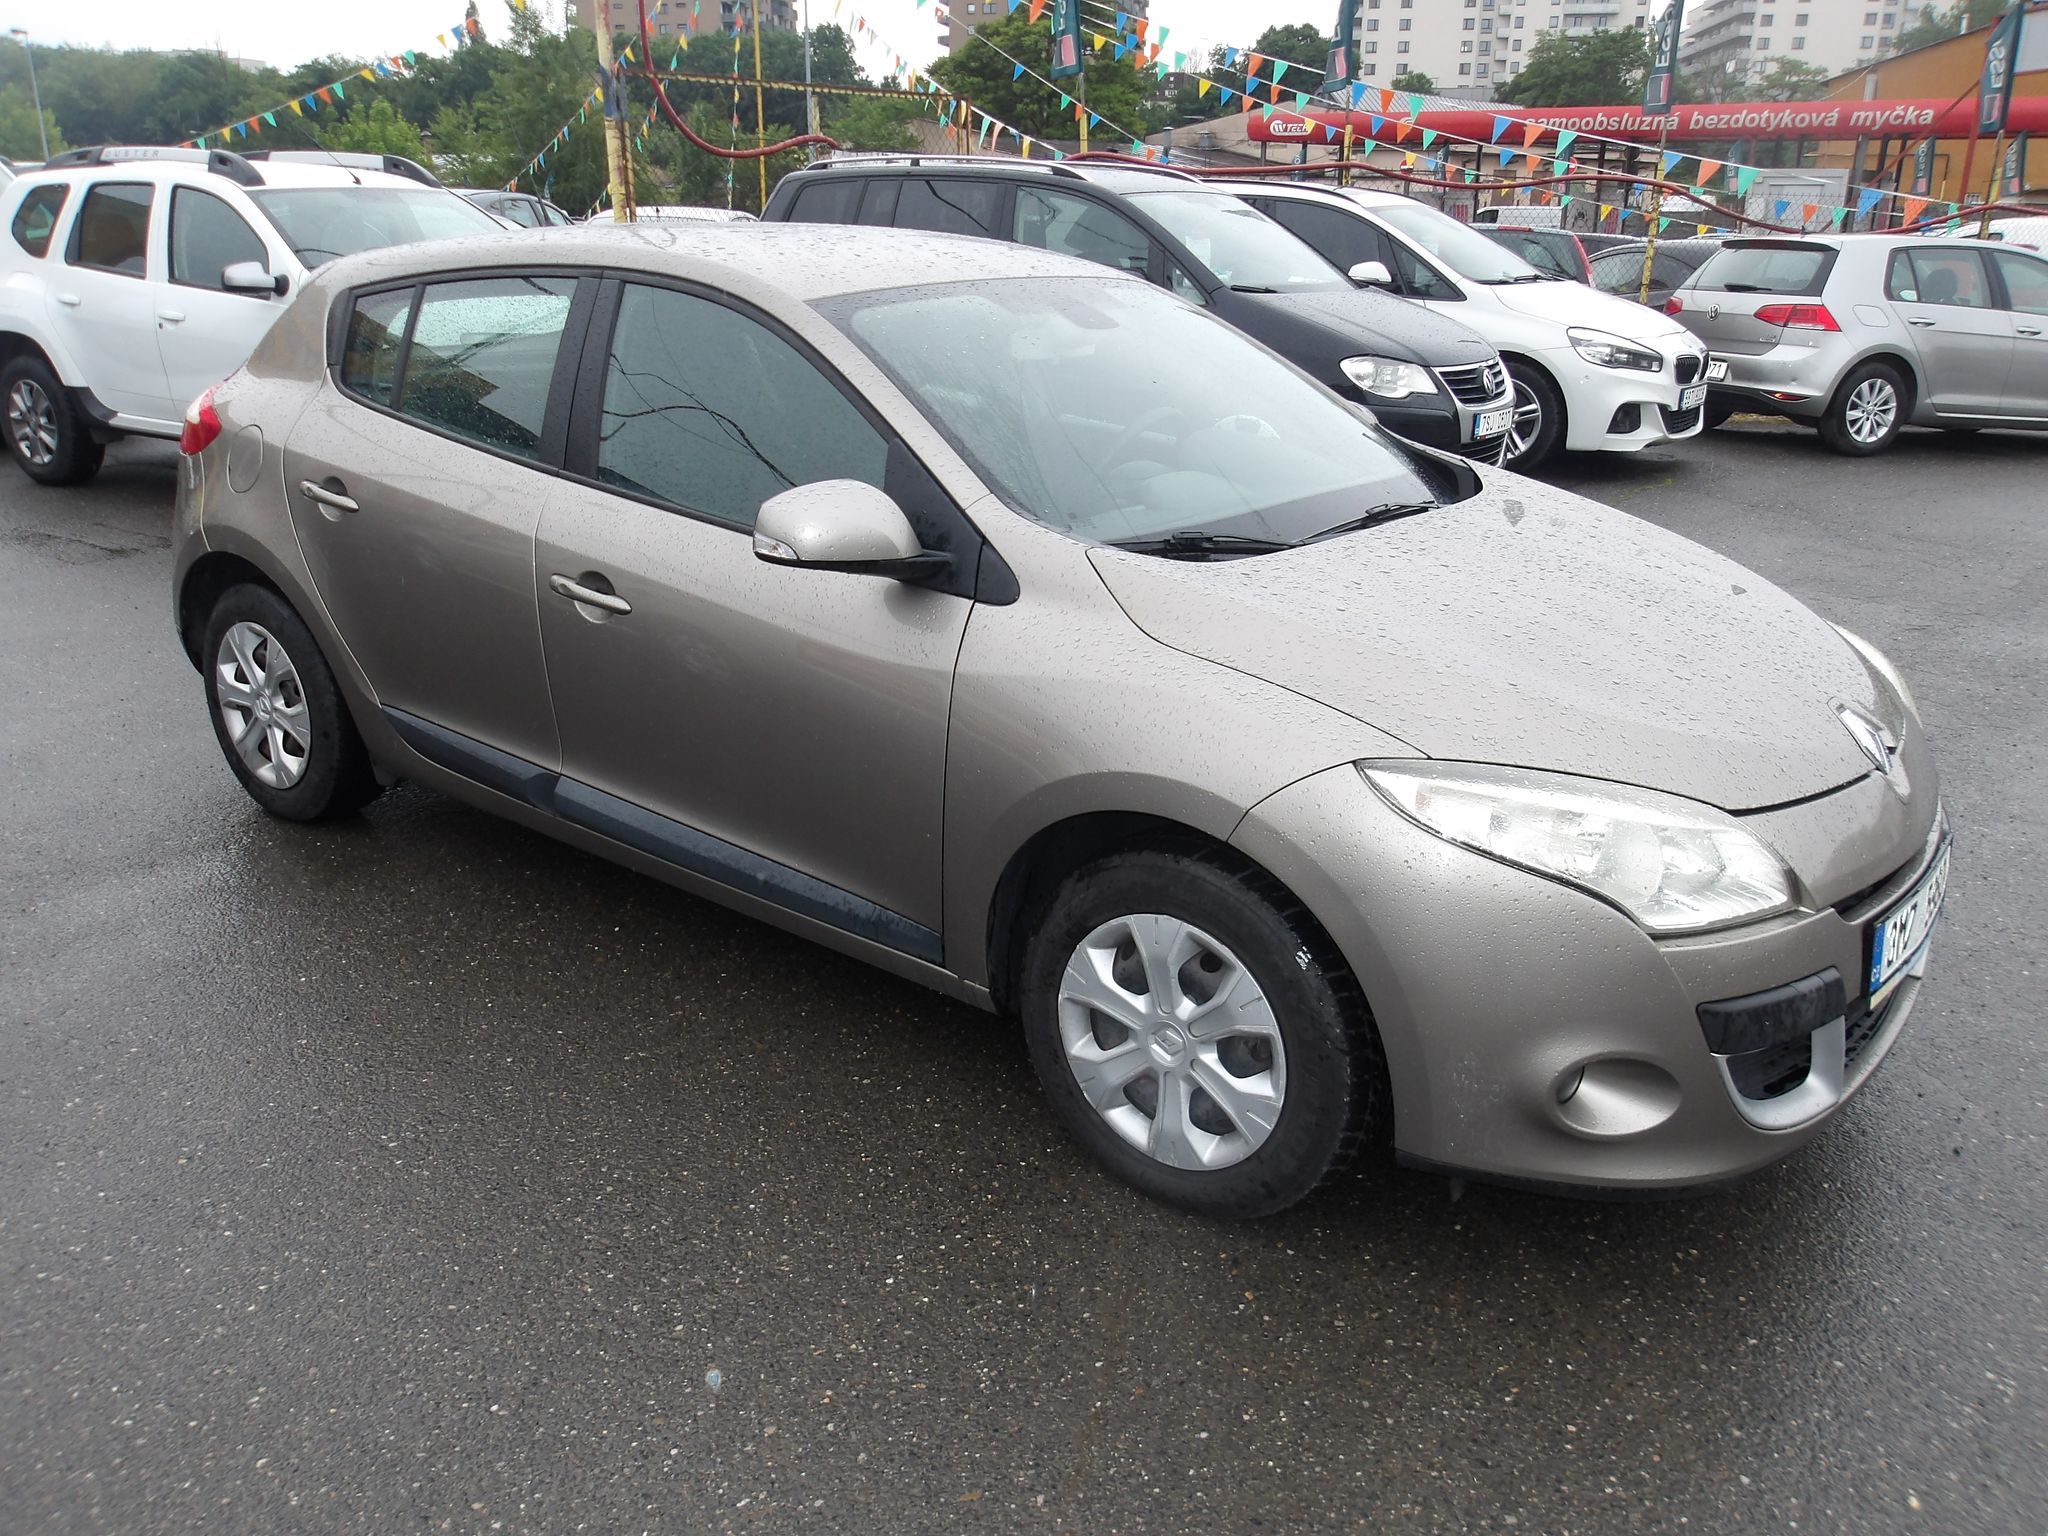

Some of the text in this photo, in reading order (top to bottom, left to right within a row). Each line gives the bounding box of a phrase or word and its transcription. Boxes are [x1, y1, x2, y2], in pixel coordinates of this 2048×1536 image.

[1689, 108, 1840, 132] bezdotyková
[1850, 105, 1935, 130] myčka
[104, 150, 160, 158] DUSTER
